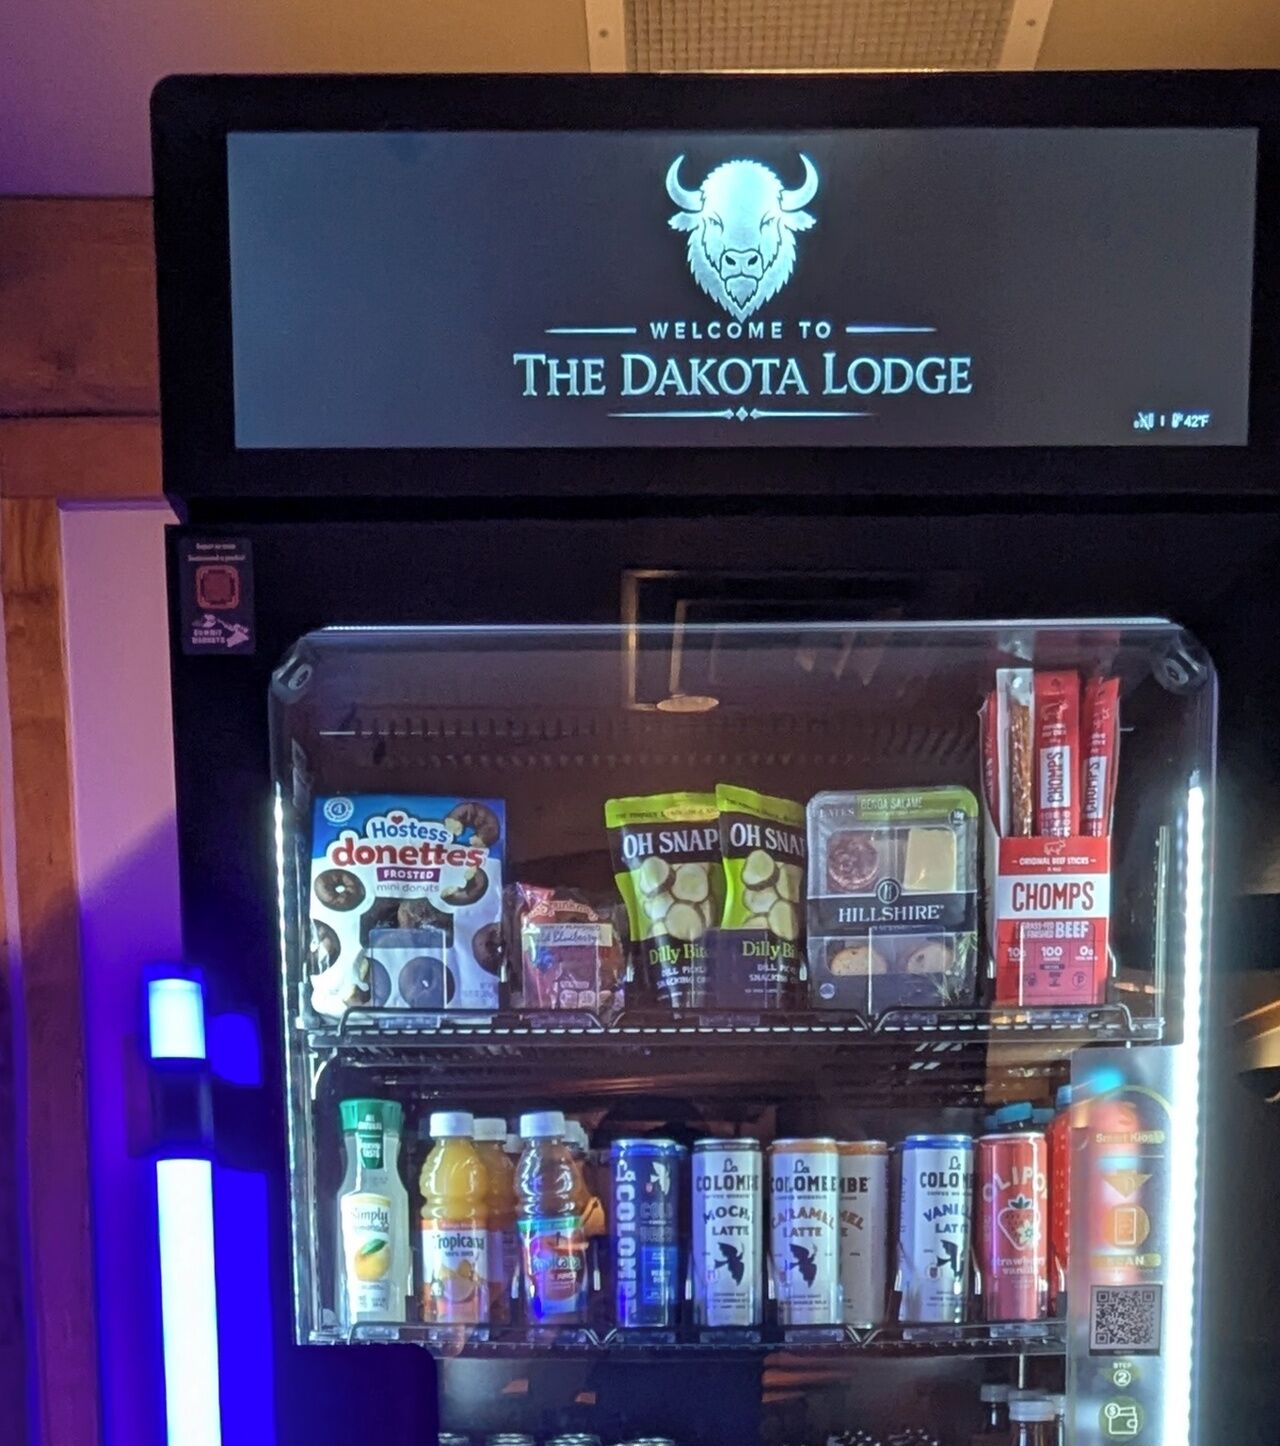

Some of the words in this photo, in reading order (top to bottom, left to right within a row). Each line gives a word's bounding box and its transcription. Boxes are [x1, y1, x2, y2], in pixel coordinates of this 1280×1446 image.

[649, 321, 783, 340] WELCOME
[799, 321, 833, 339] TO
[513, 353, 607, 397] THE
[620, 353, 810, 397] DAKOTA
[822, 351, 974, 396] LODGE
[372, 821, 449, 843] Hostess
[730, 822, 761, 848] OH
[332, 837, 485, 867] donettes
[623, 832, 654, 859] OH
[384, 869, 434, 879] FROSTED
[376, 883, 400, 892] mini
[1012, 881, 1095, 912] CHOMPS
[838, 905, 941, 923] HILLSHIRE
[1055, 921, 1089, 938] BEEF
[649, 944, 680, 965] Dilly
[684, 943, 708, 959] Bit
[742, 940, 781, 960] Dilly
[1041, 946, 1063, 957] 100
[695, 1175, 759, 1192] COLOME
[919, 1172, 974, 1188] COLO
[703, 1205, 754, 1224] MOCH
[923, 1203, 970, 1222] VANI
[935, 1224, 969, 1234] LAT
[1117, 1372, 1127, 1383] 2
